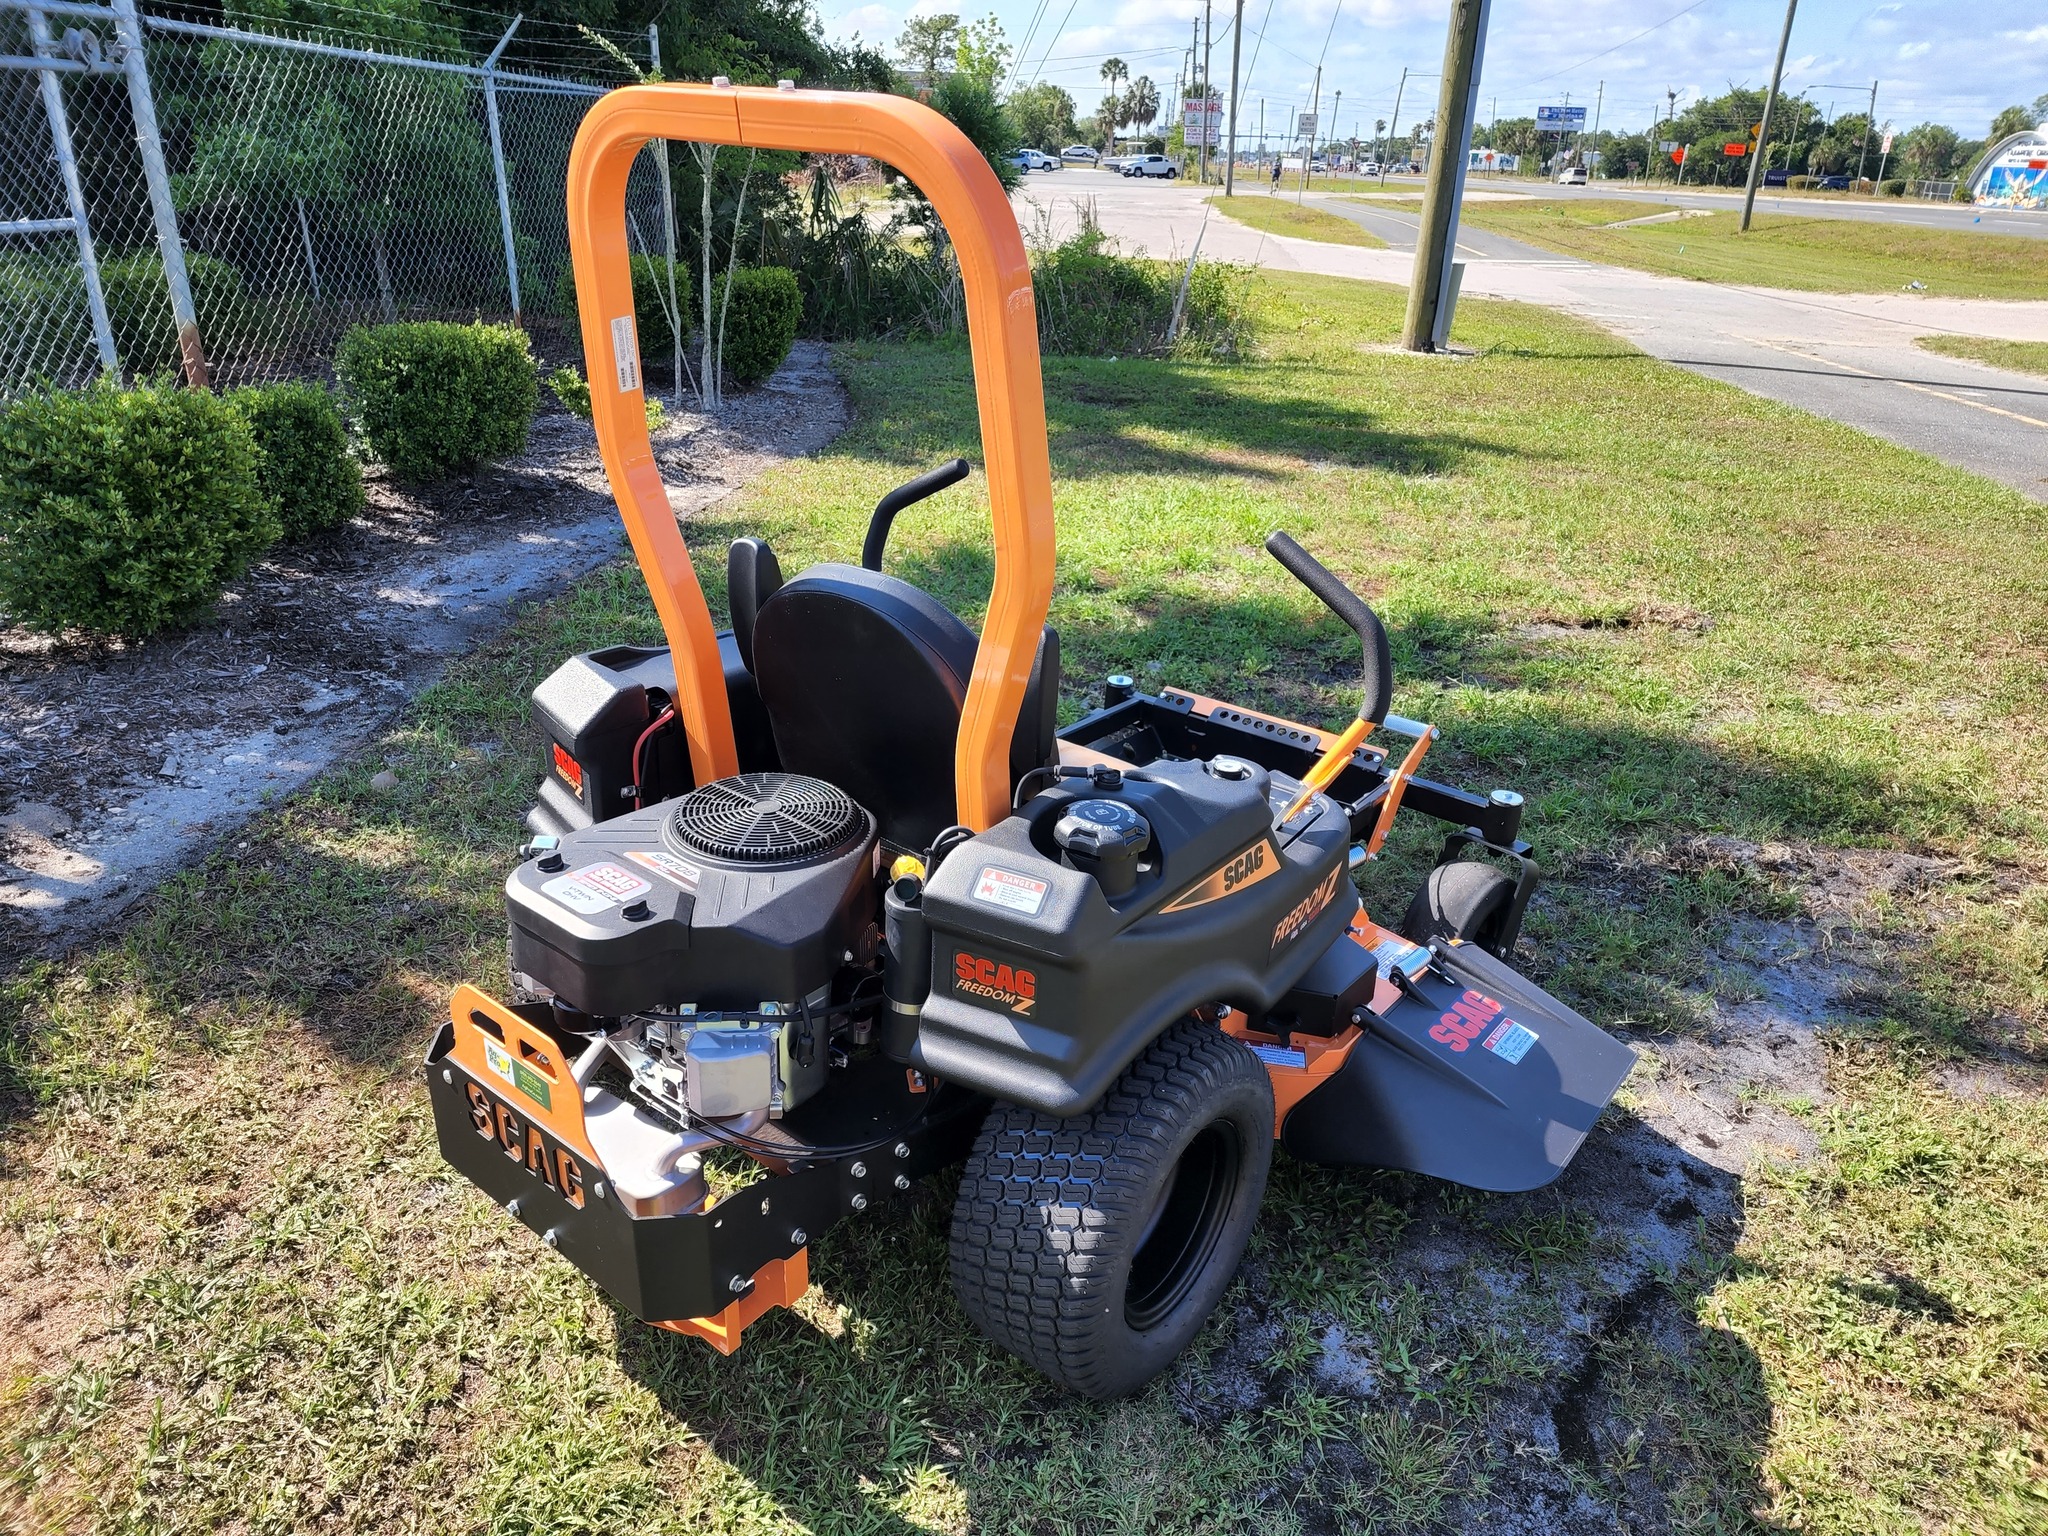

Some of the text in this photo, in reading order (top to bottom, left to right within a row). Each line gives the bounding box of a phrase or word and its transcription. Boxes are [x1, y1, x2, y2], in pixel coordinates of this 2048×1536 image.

[1186, 102, 1222, 112] MASAGE
[553, 742, 583, 785] SCAG
[556, 765, 577, 790] FREEDOM
[594, 866, 639, 889] SCAG
[1223, 845, 1264, 891] SCAG
[1002, 875, 1036, 891] DANGER
[1271, 877, 1329, 950] FREEDOM
[955, 952, 1036, 998] SCAG
[956, 979, 1016, 1005] FREEDOM
[1428, 990, 1503, 1052] SCAG
[1494, 1022, 1511, 1041] DANGER
[1262, 1042, 1292, 1051] DANGR
[464, 1081, 585, 1210] SCAG
